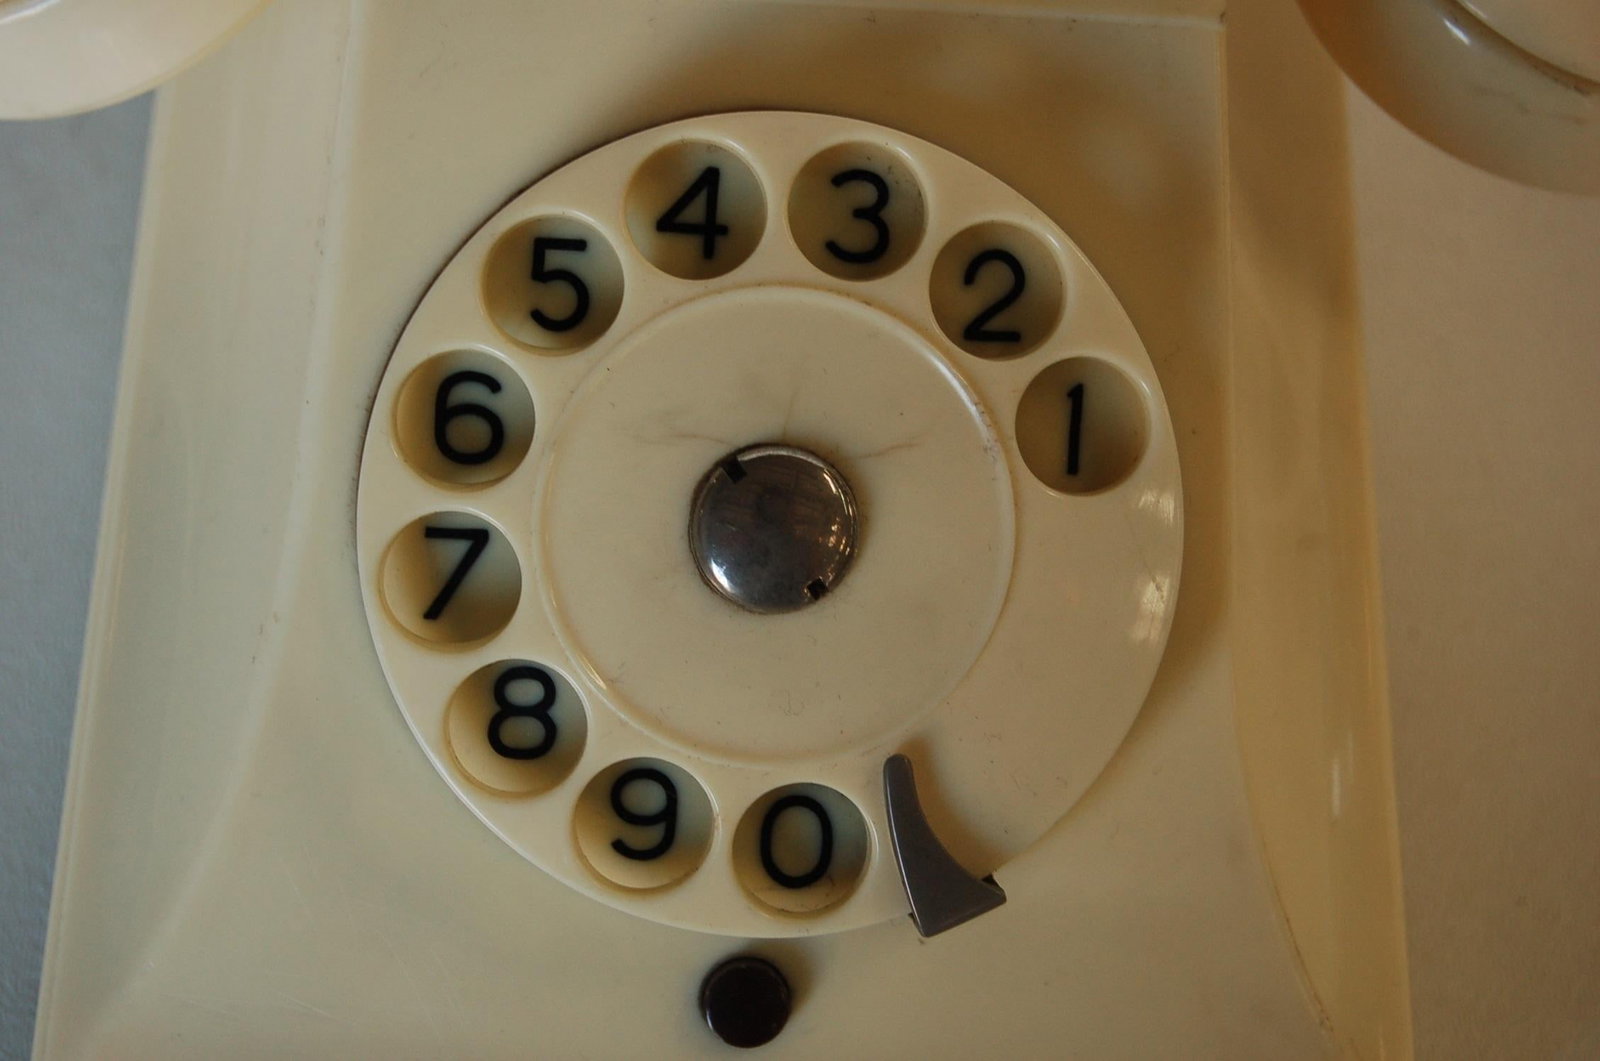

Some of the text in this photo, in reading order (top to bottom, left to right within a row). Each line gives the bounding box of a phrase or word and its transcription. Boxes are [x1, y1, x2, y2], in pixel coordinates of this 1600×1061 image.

[655, 165, 729, 260] 4
[824, 167, 891, 264] 3
[529, 236, 591, 333] 5
[962, 248, 1027, 343] 2
[432, 370, 505, 466] 6
[1065, 382, 1087, 477] 1
[423, 526, 491, 621] 7
[486, 665, 558, 761] 8
[609, 767, 678, 861] 9
[758, 793, 834, 889] 0
